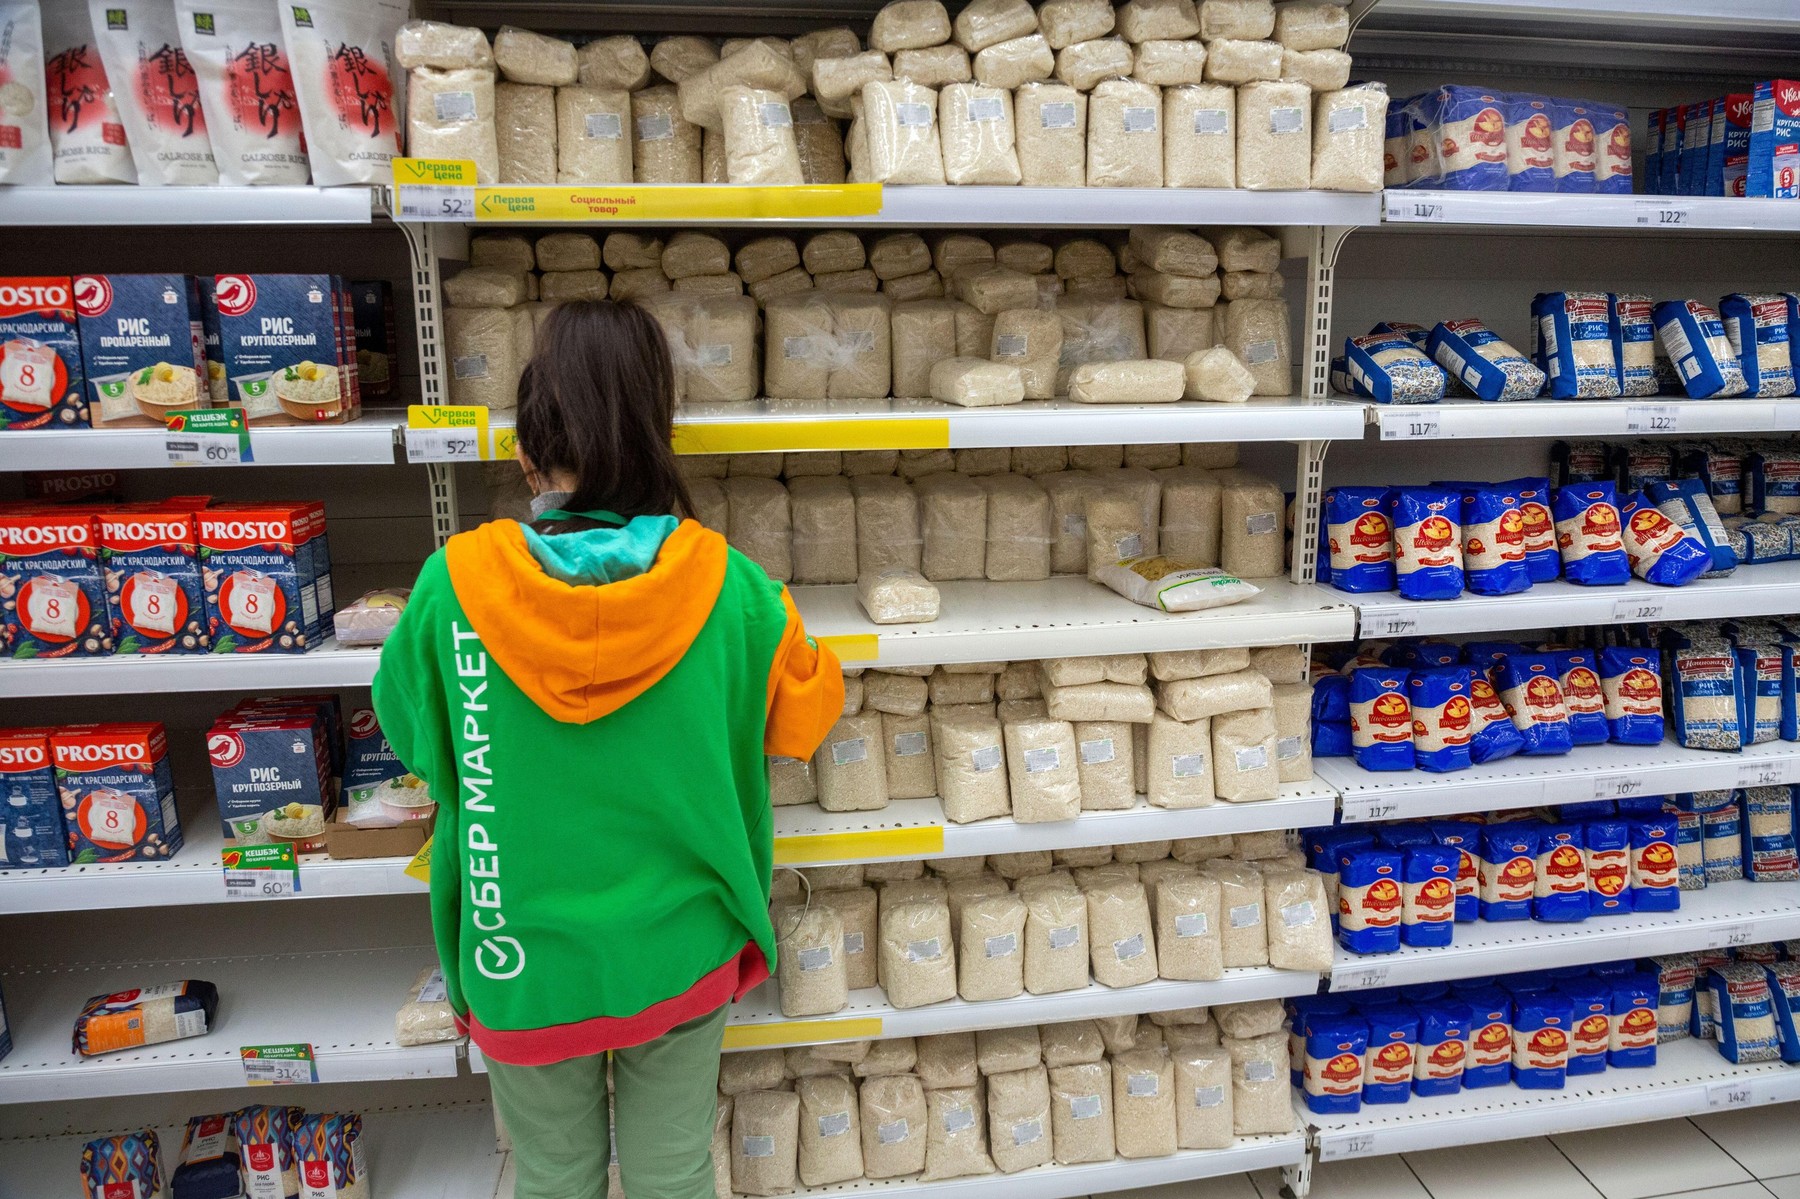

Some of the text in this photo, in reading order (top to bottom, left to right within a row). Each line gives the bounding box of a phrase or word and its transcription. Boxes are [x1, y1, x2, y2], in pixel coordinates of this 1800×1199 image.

[235, 41, 294, 139] 銀しゃり
[335, 42, 387, 138] 銀しゃり
[1776, 128, 1791, 137] РИС
[1727, 139, 1748, 148] РИС
[55, 146, 85, 158] ALROSE
[157, 152, 203, 162] CALROSE
[241, 153, 287, 162] CALROSE
[349, 152, 388, 161] CALROSE
[417, 161, 462, 174] Первая
[433, 171, 463, 180] цена
[1784, 171, 1790, 183] 5
[493, 195, 534, 206] Первая
[570, 194, 636, 205] Социальный
[442, 199, 463, 213] 52
[508, 203, 535, 212] цена
[589, 206, 618, 215] товар
[1414, 204, 1434, 217] 117
[1660, 211, 1680, 223] 122
[117, 317, 150, 336] РИС
[261, 317, 294, 335] РИС
[100, 334, 171, 347] ПРОПАРЕННЫЙ
[241, 333, 316, 347] КРУГЛОЗЕРНЫЙ
[20, 365, 35, 387] 8
[110, 383, 118, 394] 5
[252, 382, 260, 393] 5
[190, 413, 228, 422] КЕШБЭК
[433, 408, 476, 420] Первая
[448, 416, 476, 426] цена
[1650, 417, 1670, 429] 122
[1410, 423, 1430, 436] 117
[206, 446, 228, 460] 60
[447, 440, 467, 454] 52
[42, 473, 116, 494] PROSTO
[0, 525, 87, 545] PROSTO
[101, 522, 187, 540] PROSTO
[201, 521, 286, 539] PROSTO
[6, 558, 87, 571] РИС КРАСНОДАРСКИЙ
[112, 555, 185, 566] РИС КРАСНОДАРСКИЙ
[210, 554, 284, 565] РИС КРАСНОДАРСКИЙ
[46, 598, 60, 619] 8
[147, 594, 160, 615] 8
[245, 593, 258, 614] 8
[1636, 607, 1657, 618] 122
[1387, 621, 1408, 633] 117
[0, 747, 43, 763] STO
[56, 743, 144, 761] PROSTO
[361, 751, 401, 763] КРУГЛОЗ
[67, 774, 144, 785] РИС КРАСНОДАРСКИЙ
[250, 767, 280, 783] РИС
[452, 620, 507, 931] СБЕР МАРКЕТ
[1758, 772, 1776, 783] 142
[232, 779, 302, 793] КРУГЛОЗЕРНЫЙ
[1616, 784, 1635, 795] 107
[361, 790, 367, 799] 5
[1368, 807, 1388, 818] 117
[106, 811, 118, 828] 8
[244, 822, 252, 831] 5
[245, 848, 279, 857] КЕШБЭК
[263, 882, 283, 894] 60
[1362, 976, 1380, 986] 117
[276, 1068, 300, 1079] 314
